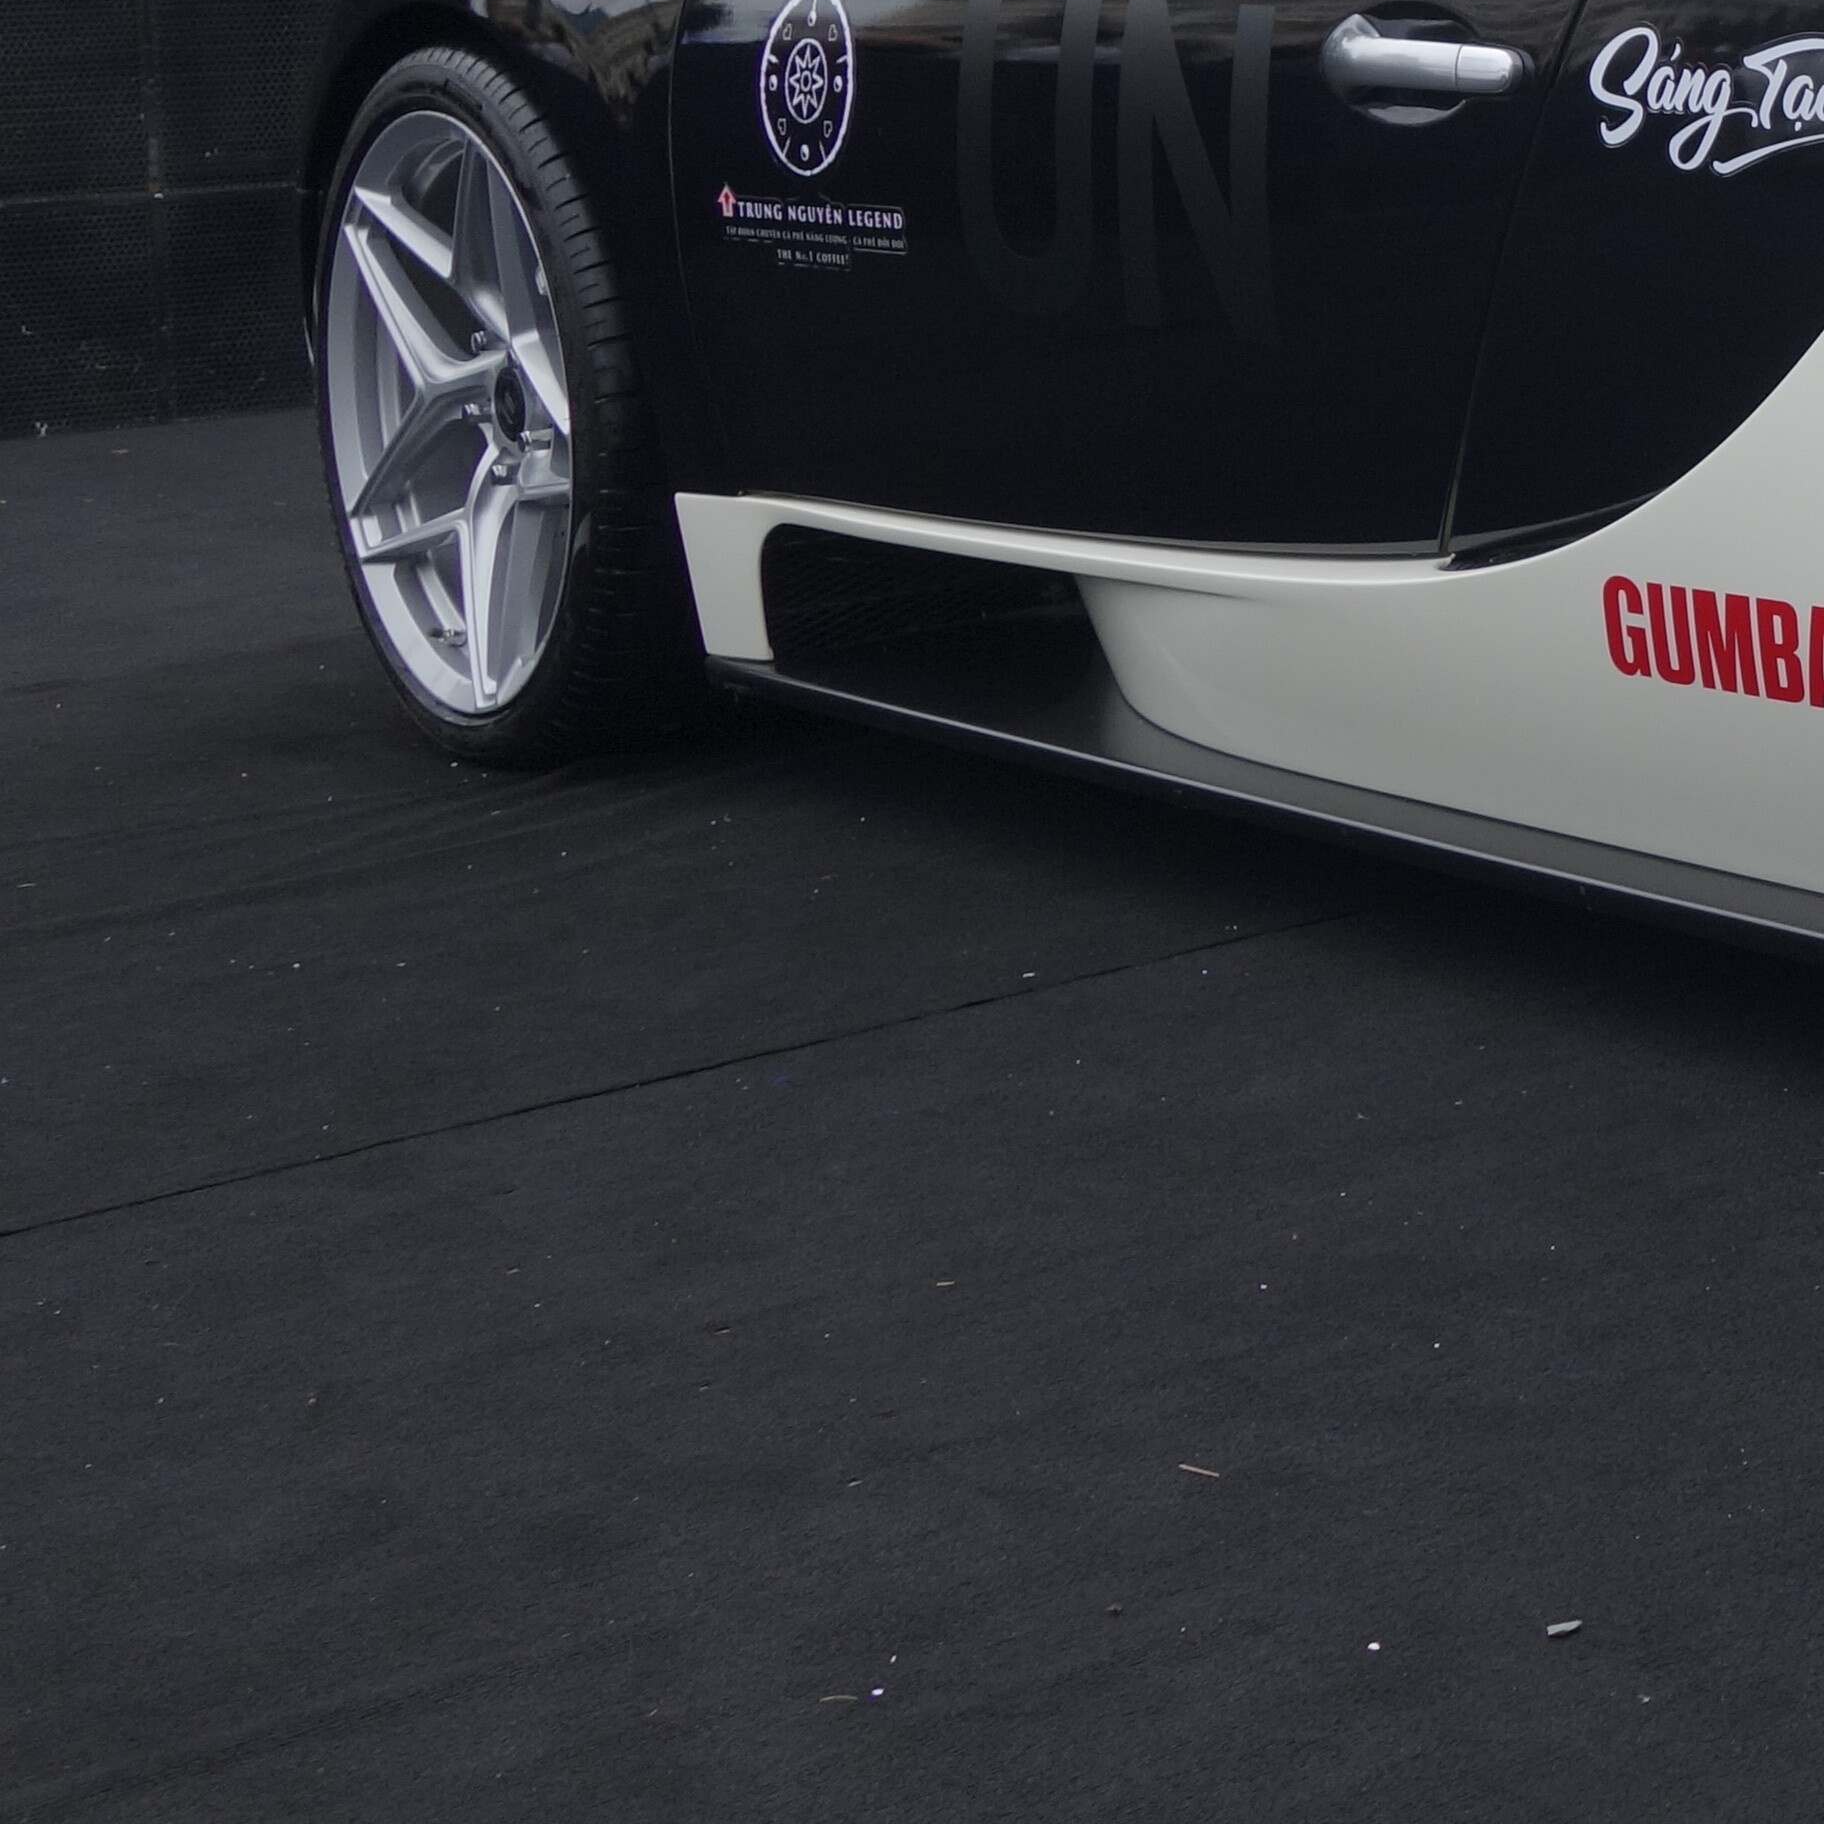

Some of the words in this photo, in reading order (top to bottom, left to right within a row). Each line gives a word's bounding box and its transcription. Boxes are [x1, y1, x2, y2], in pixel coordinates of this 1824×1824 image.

[1589, 26, 1758, 172] Sáng
[738, 201, 782, 221] TRUNG
[788, 204, 842, 225] NGUYÊN
[848, 209, 903, 229] LEGEND
